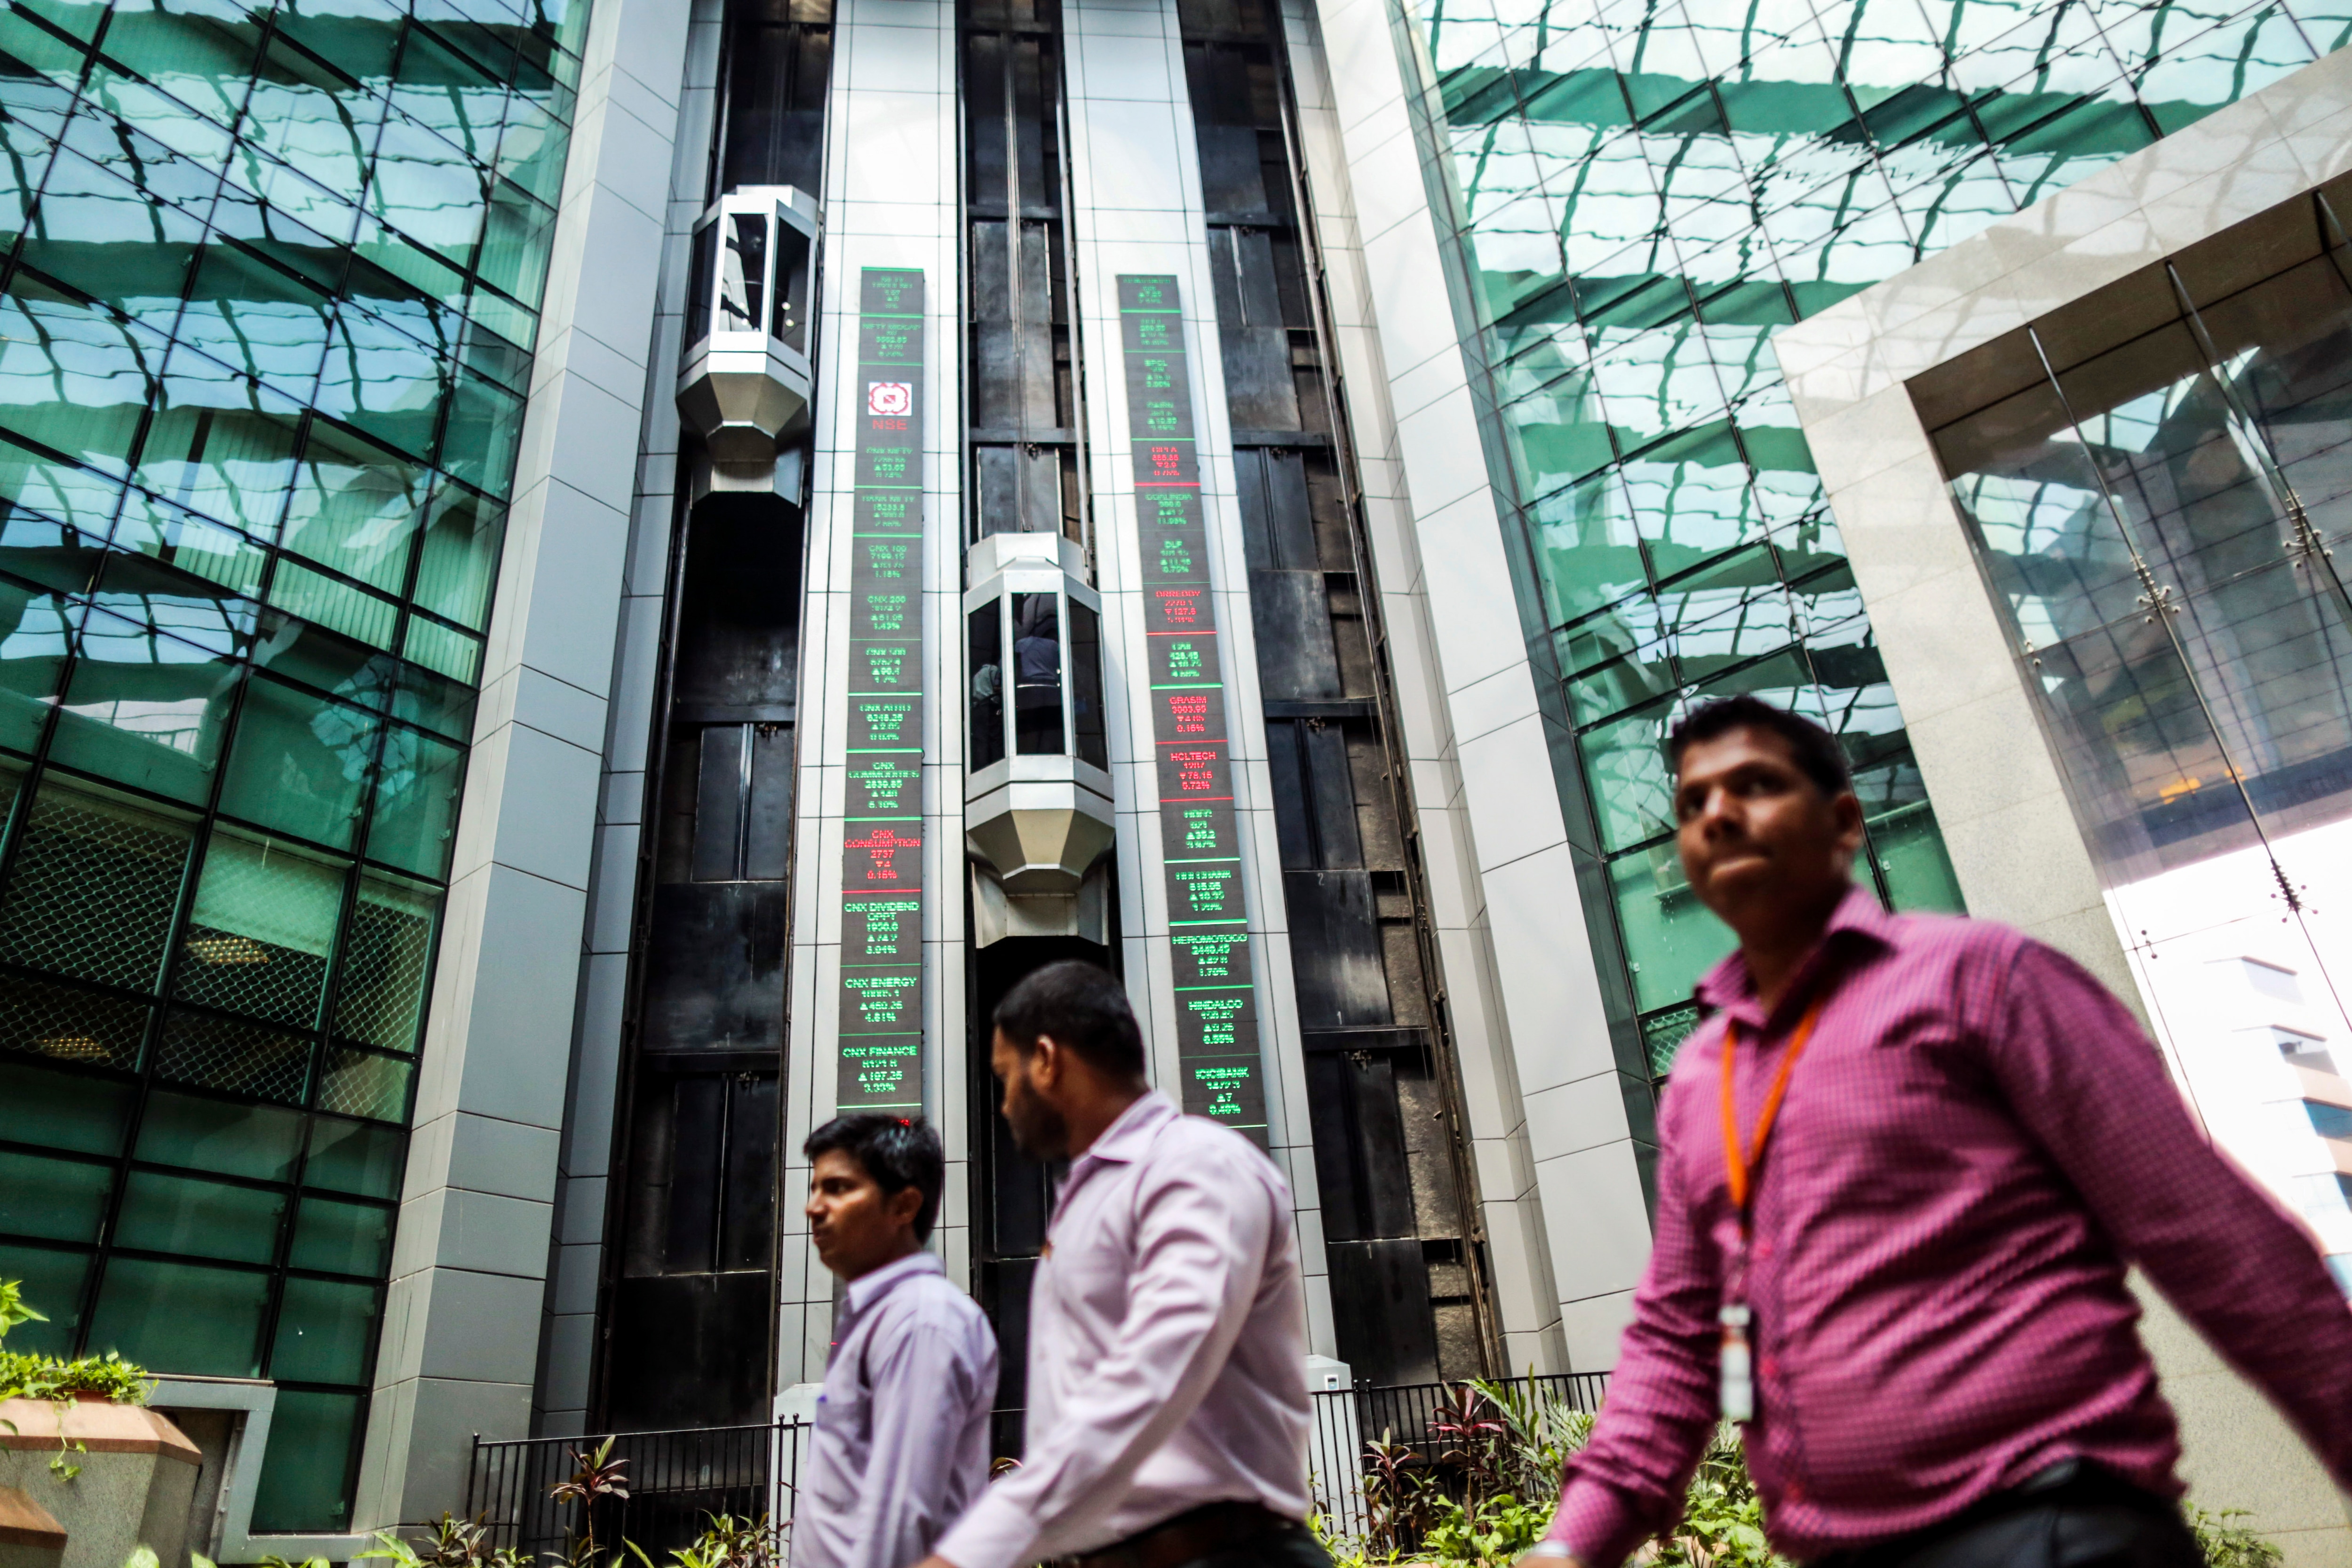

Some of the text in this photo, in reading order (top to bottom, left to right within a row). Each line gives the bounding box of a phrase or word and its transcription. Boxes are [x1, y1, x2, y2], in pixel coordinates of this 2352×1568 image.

[872, 419, 907, 430] NSE
[1170, 752, 1216, 761] HCLTECH
[845, 839, 921, 848] CONSUMPTION
[870, 850, 895, 858] 2737
[844, 901, 919, 912] CNX DIVIDEND
[1172, 934, 1248, 944] HEROMOTOCO
[845, 977, 917, 988] CNX ENERGY
[1188, 999, 1243, 1010] HINDALCO
[842, 1046, 917, 1057] CNX FINANCE
[1195, 1067, 1249, 1079] ICICIBANK
